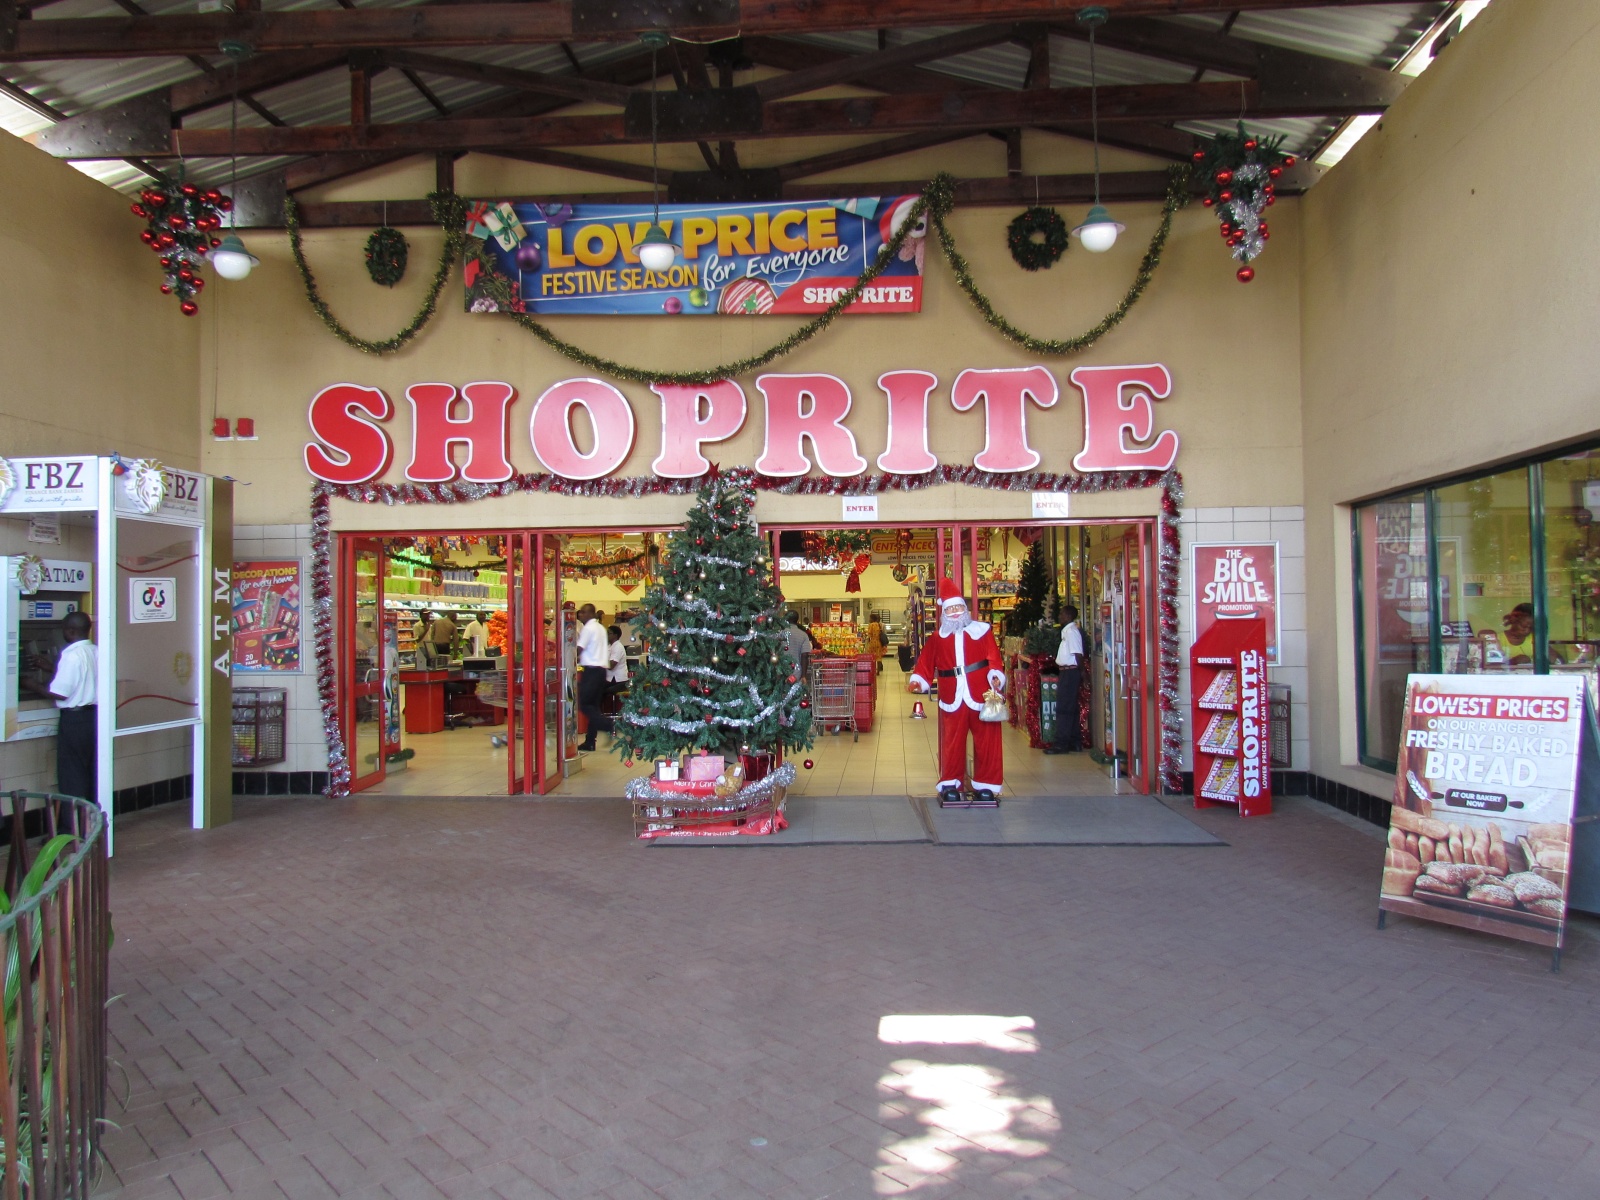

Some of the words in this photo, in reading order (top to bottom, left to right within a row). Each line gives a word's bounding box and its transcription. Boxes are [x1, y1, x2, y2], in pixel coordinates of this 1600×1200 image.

[547, 220, 674, 268] LOW
[682, 207, 838, 259] PRICE
[542, 269, 617, 295] FESTIVE
[620, 264, 697, 291] SEASON
[703, 254, 736, 291] for
[746, 244, 849, 287] Everyone
[303, 363, 1179, 485] SHOPRITE
[25, 462, 83, 489] FBZ
[1036, 501, 1066, 510] ENTER
[875, 541, 930, 552] ENTNCE
[1225, 549, 1242, 559] THE
[42, 567, 76, 583] ATM
[233, 566, 298, 579] DECORATIONS
[1214, 558, 1256, 582] BIG
[240, 579, 252, 593] for
[252, 577, 272, 589] every
[273, 574, 294, 585] home
[1201, 581, 1268, 604] SMILE
[213, 567, 230, 678] ATM
[245, 653, 254, 661] 20
[1198, 702, 1233, 710] SHOPRITE
[1414, 696, 1491, 716] LOWEST
[1495, 698, 1566, 720] PRICES
[1240, 649, 1260, 797] SHOPRITE
[1427, 718, 1447, 730] ON
[1449, 719, 1475, 732] OUR
[1478, 721, 1523, 734] RANGE
[1526, 723, 1545, 735] OF
[1200, 746, 1234, 756] SHOPRITE
[1405, 729, 1487, 752] FRESHLY
[1492, 734, 1568, 758] BAKED
[1424, 750, 1539, 788] BREAD
[673, 780, 696, 789] Merry
[1201, 791, 1236, 802] SHOPRITE
[1461, 792, 1475, 800] OUR
[1475, 793, 1503, 802] BAKERY
[1466, 799, 1485, 808] NOW
